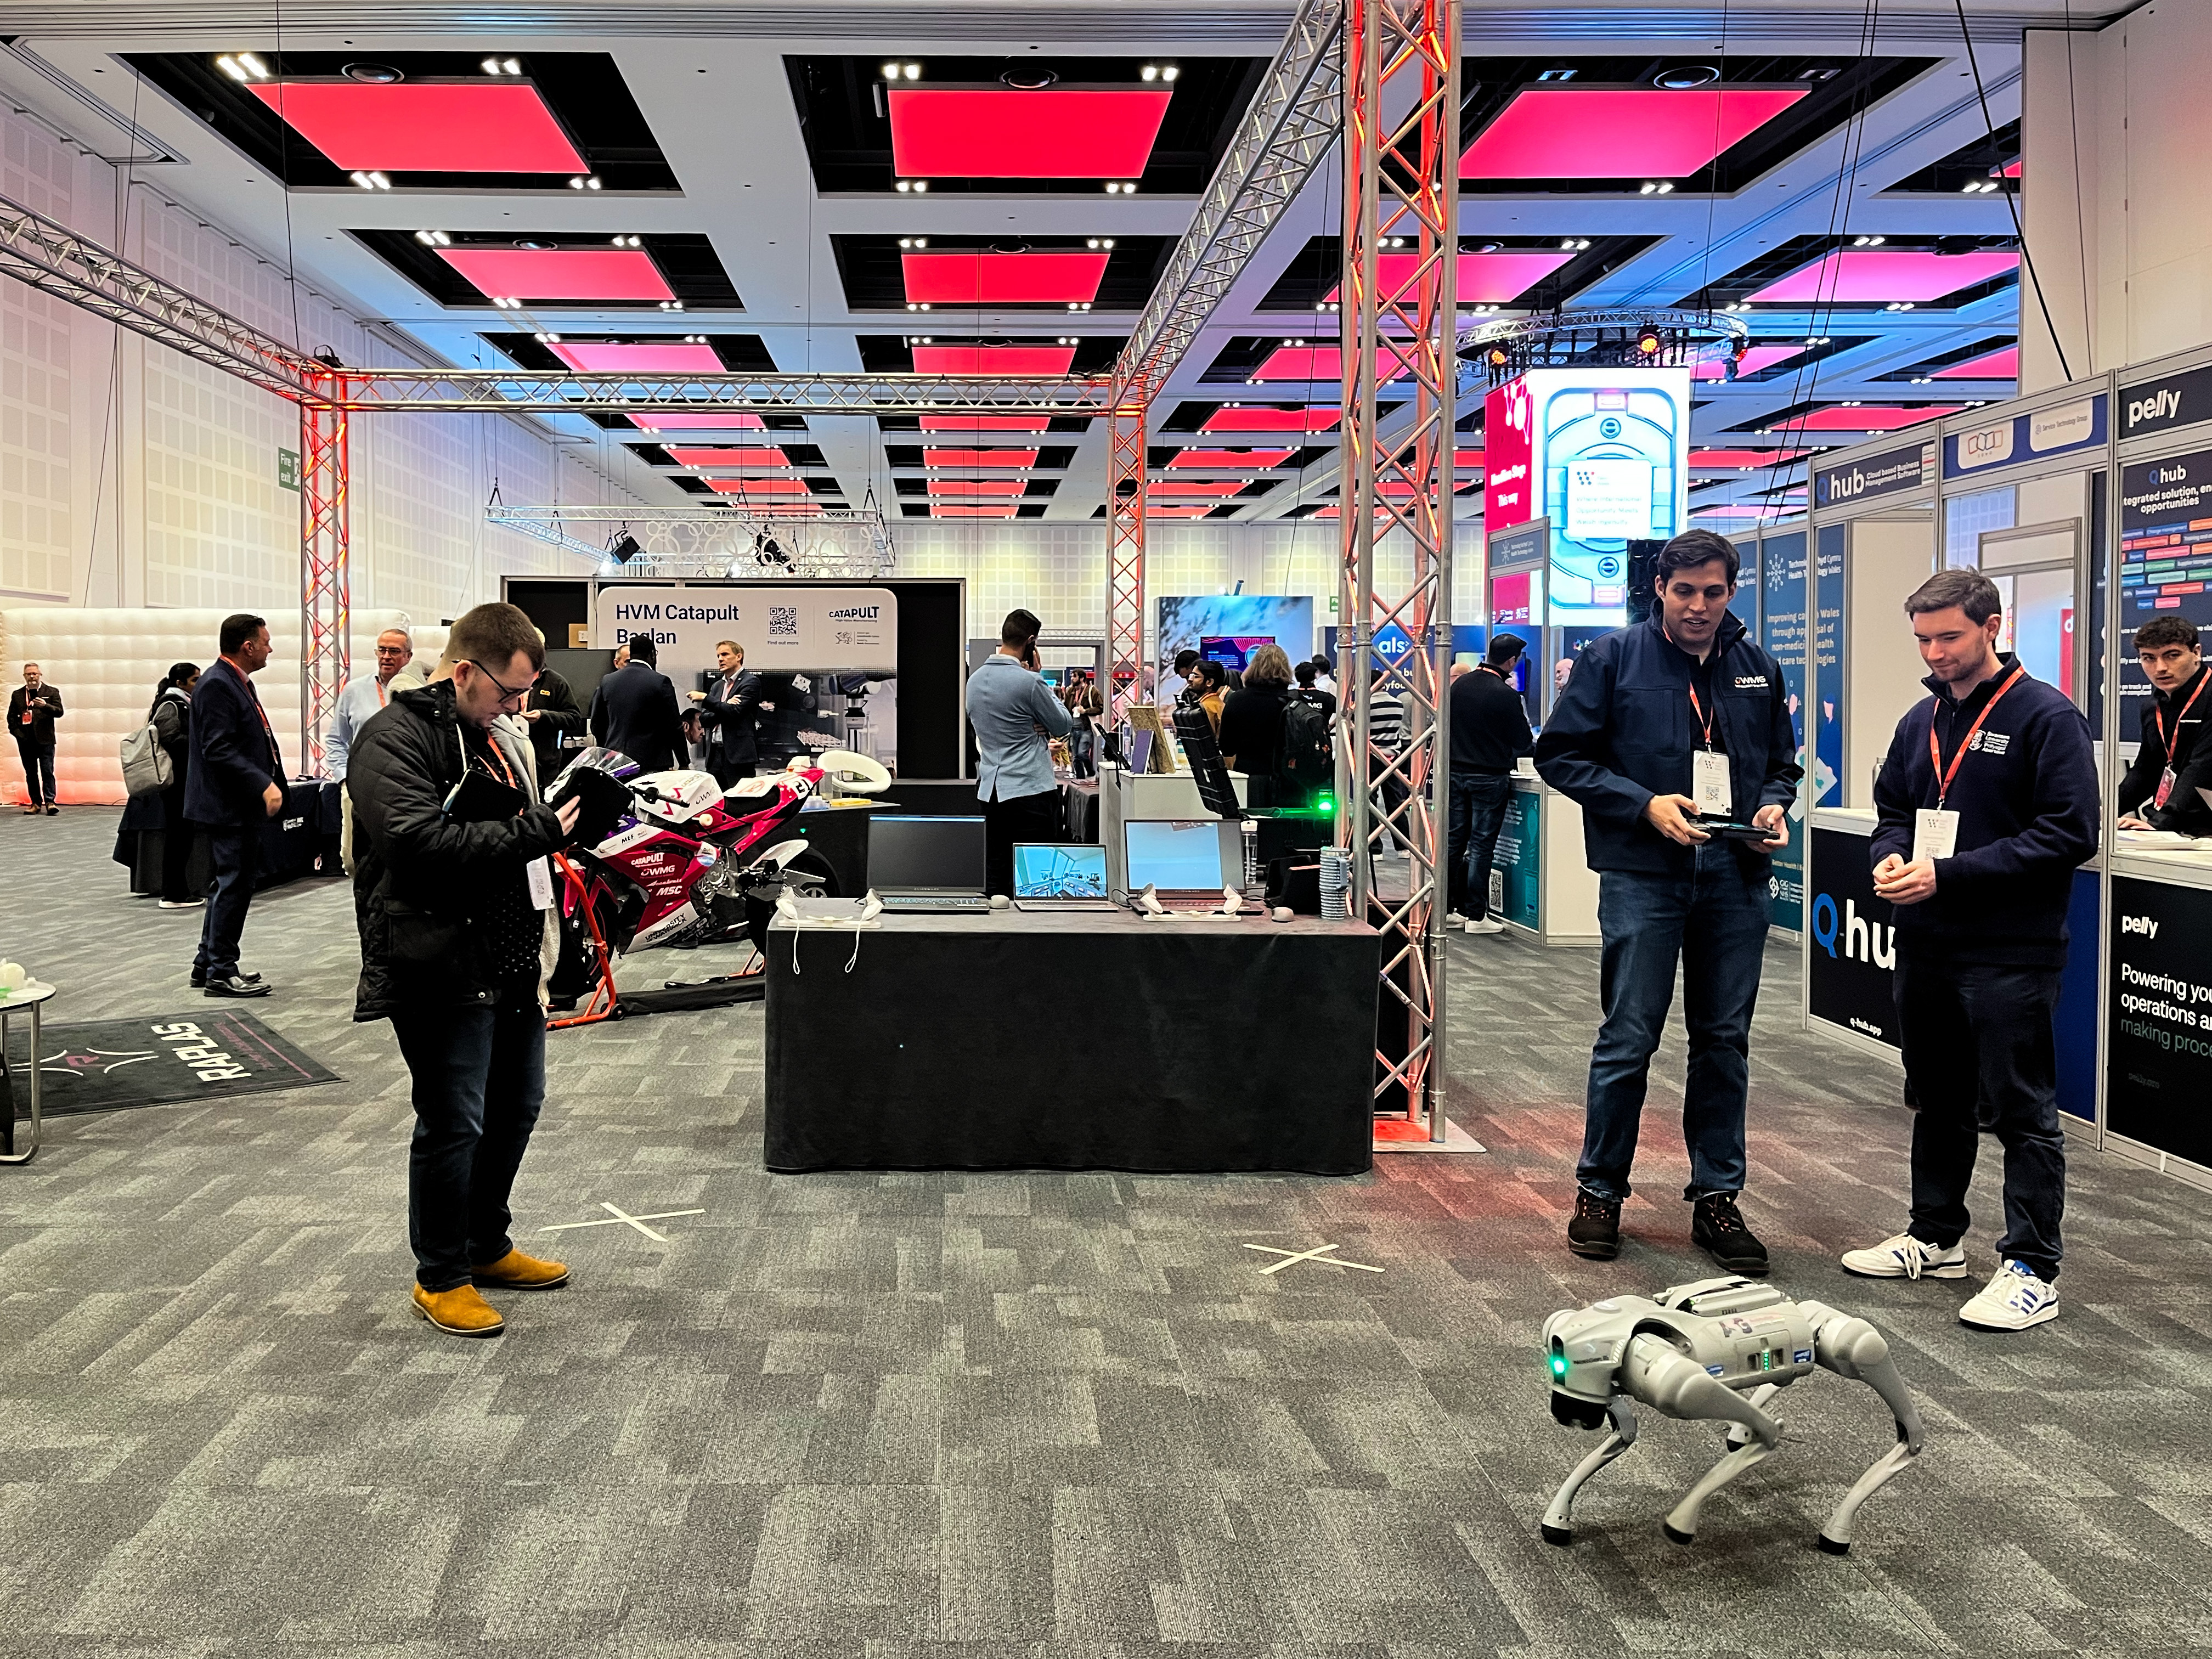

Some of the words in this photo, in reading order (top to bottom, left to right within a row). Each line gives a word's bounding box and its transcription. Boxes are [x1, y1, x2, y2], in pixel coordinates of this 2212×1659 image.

[2129, 389, 2181, 428] pelly
[280, 453, 291, 467] Fire
[281, 472, 291, 483] exit
[2161, 486, 2199, 501] solution,
[2200, 484, 2212, 494] en
[2141, 496, 2199, 514] opportunities
[617, 605, 660, 619] HVM
[665, 604, 739, 624] Catapult
[829, 606, 879, 618] CATAPULT
[1767, 612, 1797, 624] Improving
[1820, 608, 1839, 618] Wales
[1772, 627, 1796, 639] through
[1827, 623, 1835, 633] of
[1817, 639, 1834, 649] ealth
[1740, 675, 1766, 684] WMG
[631, 853, 665, 866] CATAPULT
[650, 865, 675, 876] WMG
[656, 885, 682, 896] MSC
[645, 913, 685, 940] UNIVERSITY
[2122, 916, 2158, 939] pelly
[2121, 963, 2187, 1001] Powering
[2121, 994, 2196, 1026] operations
[1850, 1018, 1882, 1036] q-hub.app
[2121, 1018, 2170, 1050] making
[151, 1022, 252, 1081] RAPLAS
